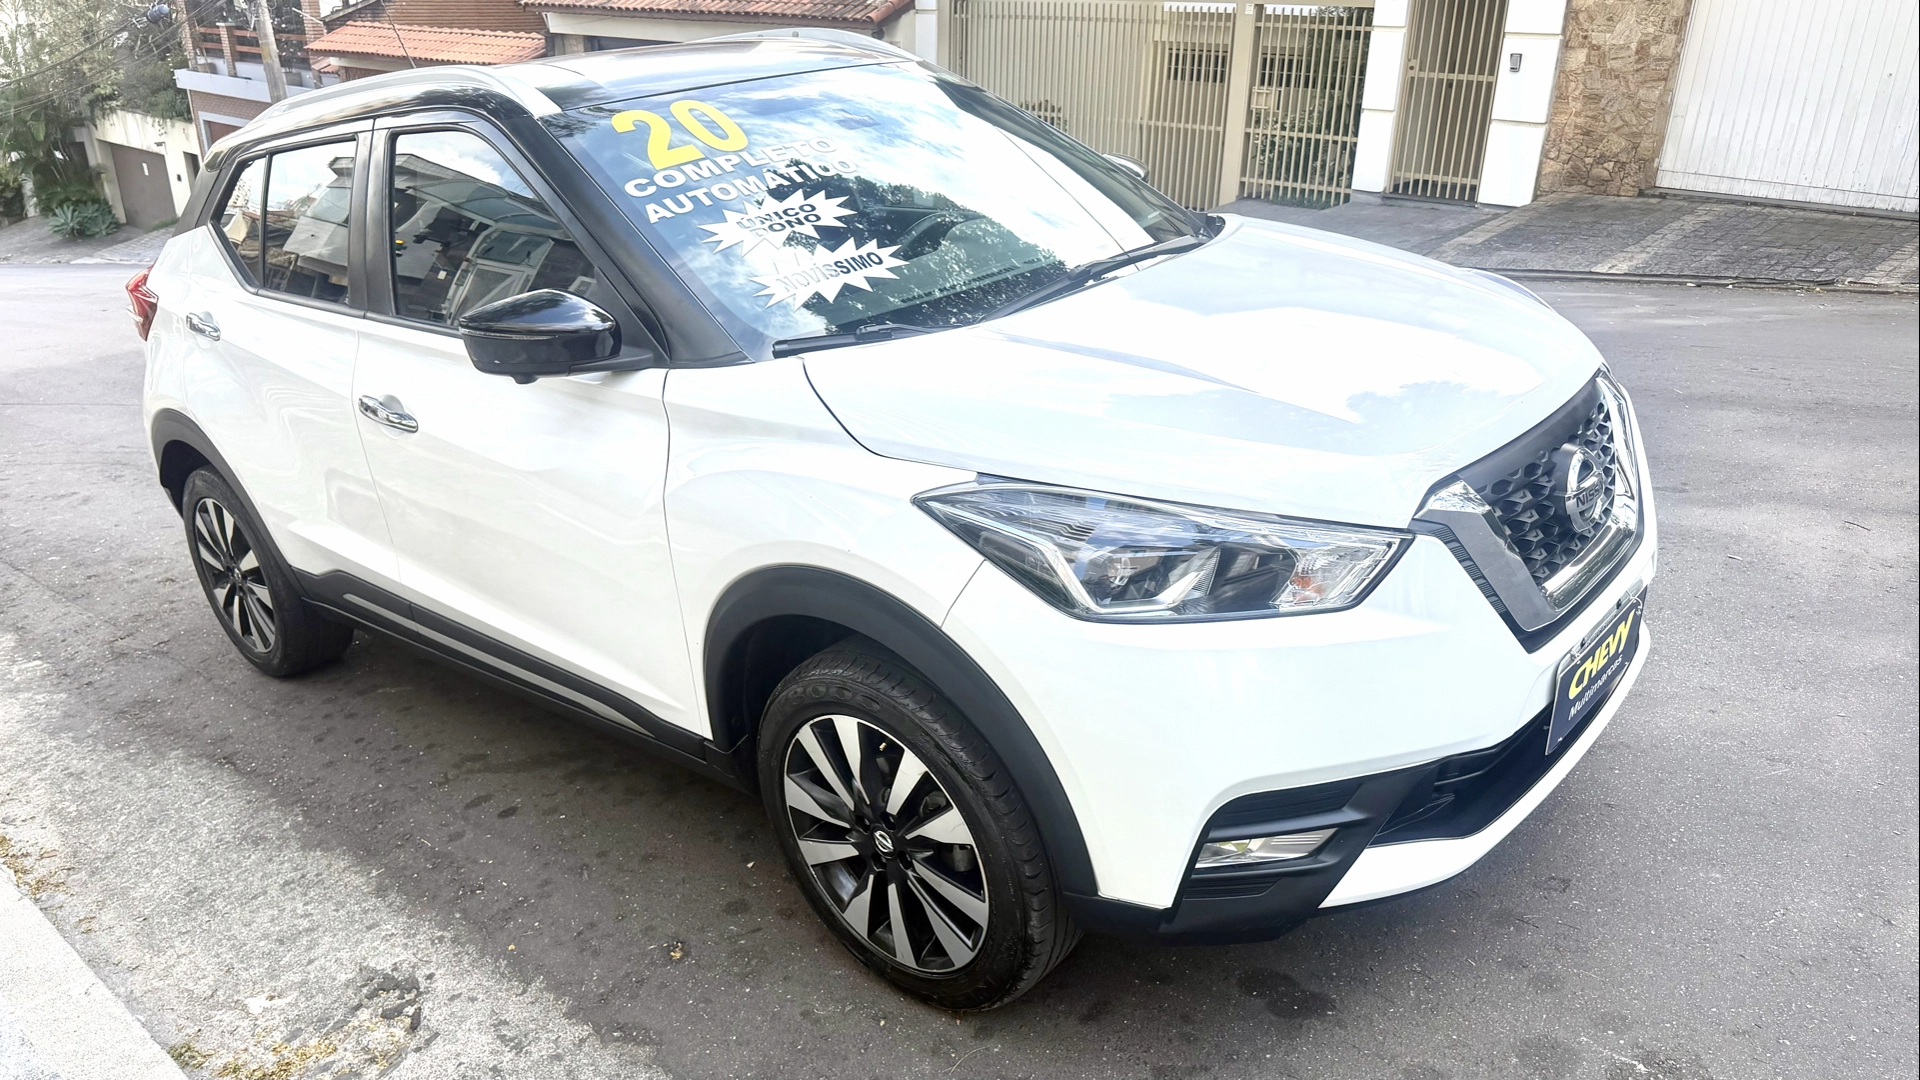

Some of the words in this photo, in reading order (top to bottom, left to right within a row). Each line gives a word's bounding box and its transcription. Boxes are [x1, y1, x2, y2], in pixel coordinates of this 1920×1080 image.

[611, 99, 748, 170] 20
[624, 136, 838, 198] COMPLETO
[645, 157, 857, 224] AUTOMÁTICO
[736, 203, 817, 230] ÚNICO
[749, 213, 822, 239] DONO
[776, 251, 884, 293] NOVÍSSIMO
[1569, 608, 1636, 700] CHEVY
[1567, 654, 1623, 721] Multimarcas
